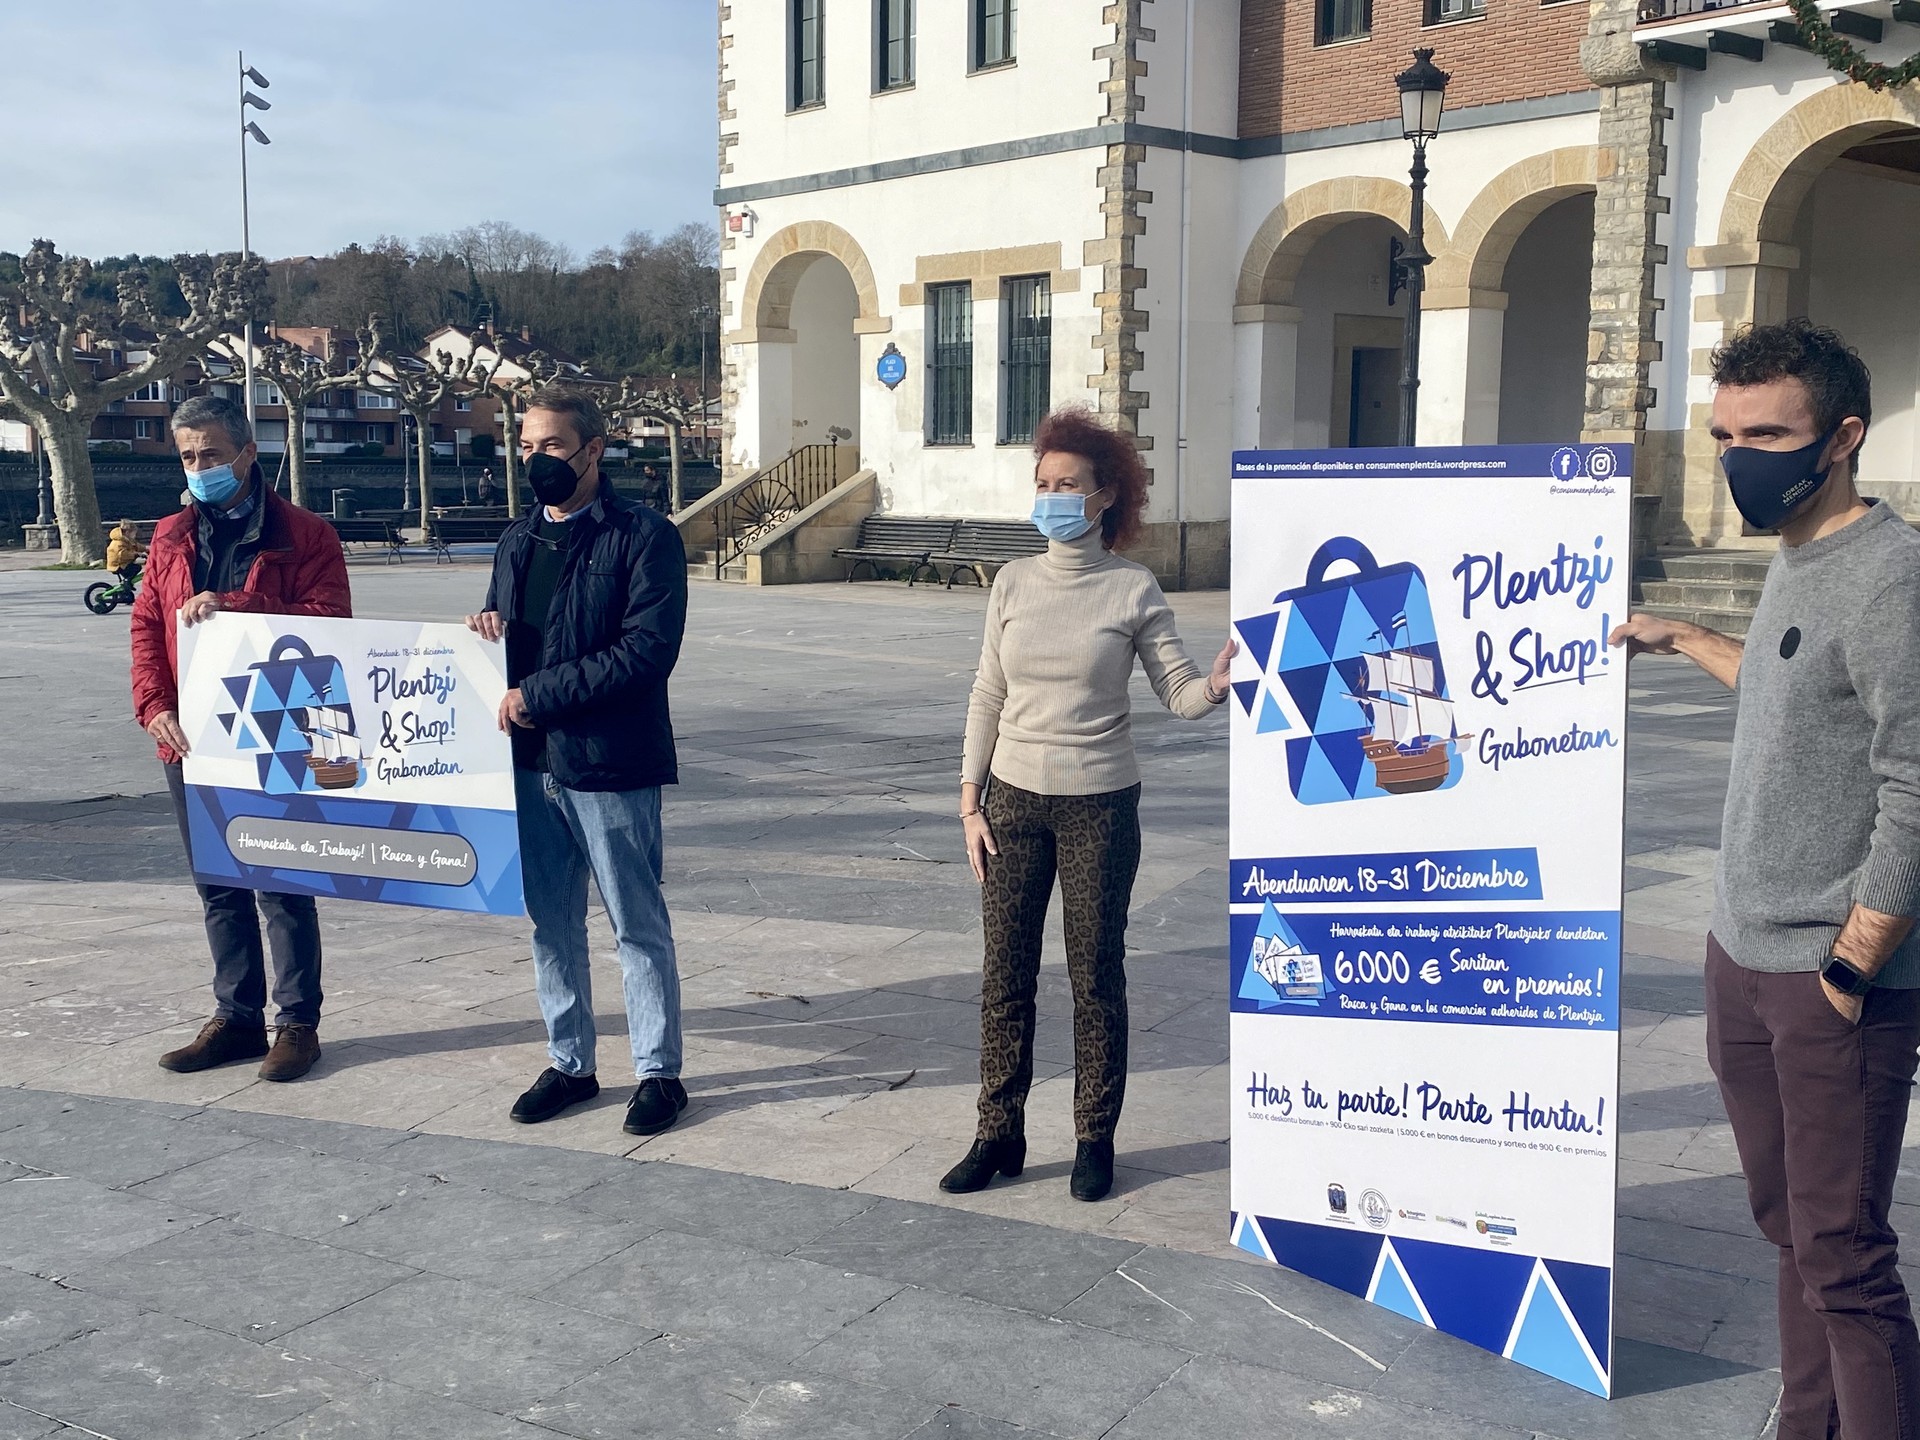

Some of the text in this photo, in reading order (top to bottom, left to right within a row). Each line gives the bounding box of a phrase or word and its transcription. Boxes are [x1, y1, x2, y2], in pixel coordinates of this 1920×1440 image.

[1235, 463, 1255, 471] Bases
[1256, 462, 1265, 471] de
[1266, 462, 1272, 471] la
[1273, 461, 1311, 472] promoción
[1312, 461, 1353, 472] disponibles
[1366, 459, 1507, 471] consumeenplentzia.wordpress.com
[1452, 535, 1613, 619] Plentzi
[1471, 613, 1610, 705] & Shop!
[367, 665, 456, 704] Plentzi
[380, 707, 455, 753] & Shop!
[1479, 722, 1618, 771] Gabonetan
[377, 757, 463, 785] Gabonetan
[238, 832, 297, 851] Harraskatu
[300, 840, 317, 853] eta
[319, 839, 365, 861] Irabazi!
[380, 844, 415, 863] Rasca
[418, 854, 427, 869] y
[430, 848, 468, 869] Gana!
[1242, 858, 1528, 896] Abenduaren 18-31 Diciembre
[1330, 922, 1608, 944] Harraskatu eta irabazi atxikitako Plentziako dendetan
[1335, 950, 1410, 984] 6.000
[1419, 958, 1442, 985] €
[1450, 948, 1510, 973] Saritan
[1483, 977, 1510, 995] en
[1339, 993, 1605, 1026] Rasca y Gana en los comercios adheridos de Plentzia
[1247, 1071, 1292, 1116] Haz
[1301, 1079, 1328, 1109] tu
[1338, 1082, 1409, 1122] parte!
[1416, 1080, 1493, 1125] Parte
[1270, 1114, 1298, 1124] deskontu
[1330, 1121, 1342, 1129] 900
[1400, 1128, 1419, 1137] 5.000
[1420, 1130, 1426, 1138] €
[1426, 1131, 1436, 1139] en
[1437, 1132, 1459, 1141] bonos
[1459, 1135, 1497, 1146] descuento
[1504, 1140, 1527, 1149] sorteo
[1528, 1142, 1538, 1150] de
[1539, 1143, 1554, 1152] 900
[1555, 1144, 1562, 1152] €
[1575, 1148, 1607, 1158] premios
